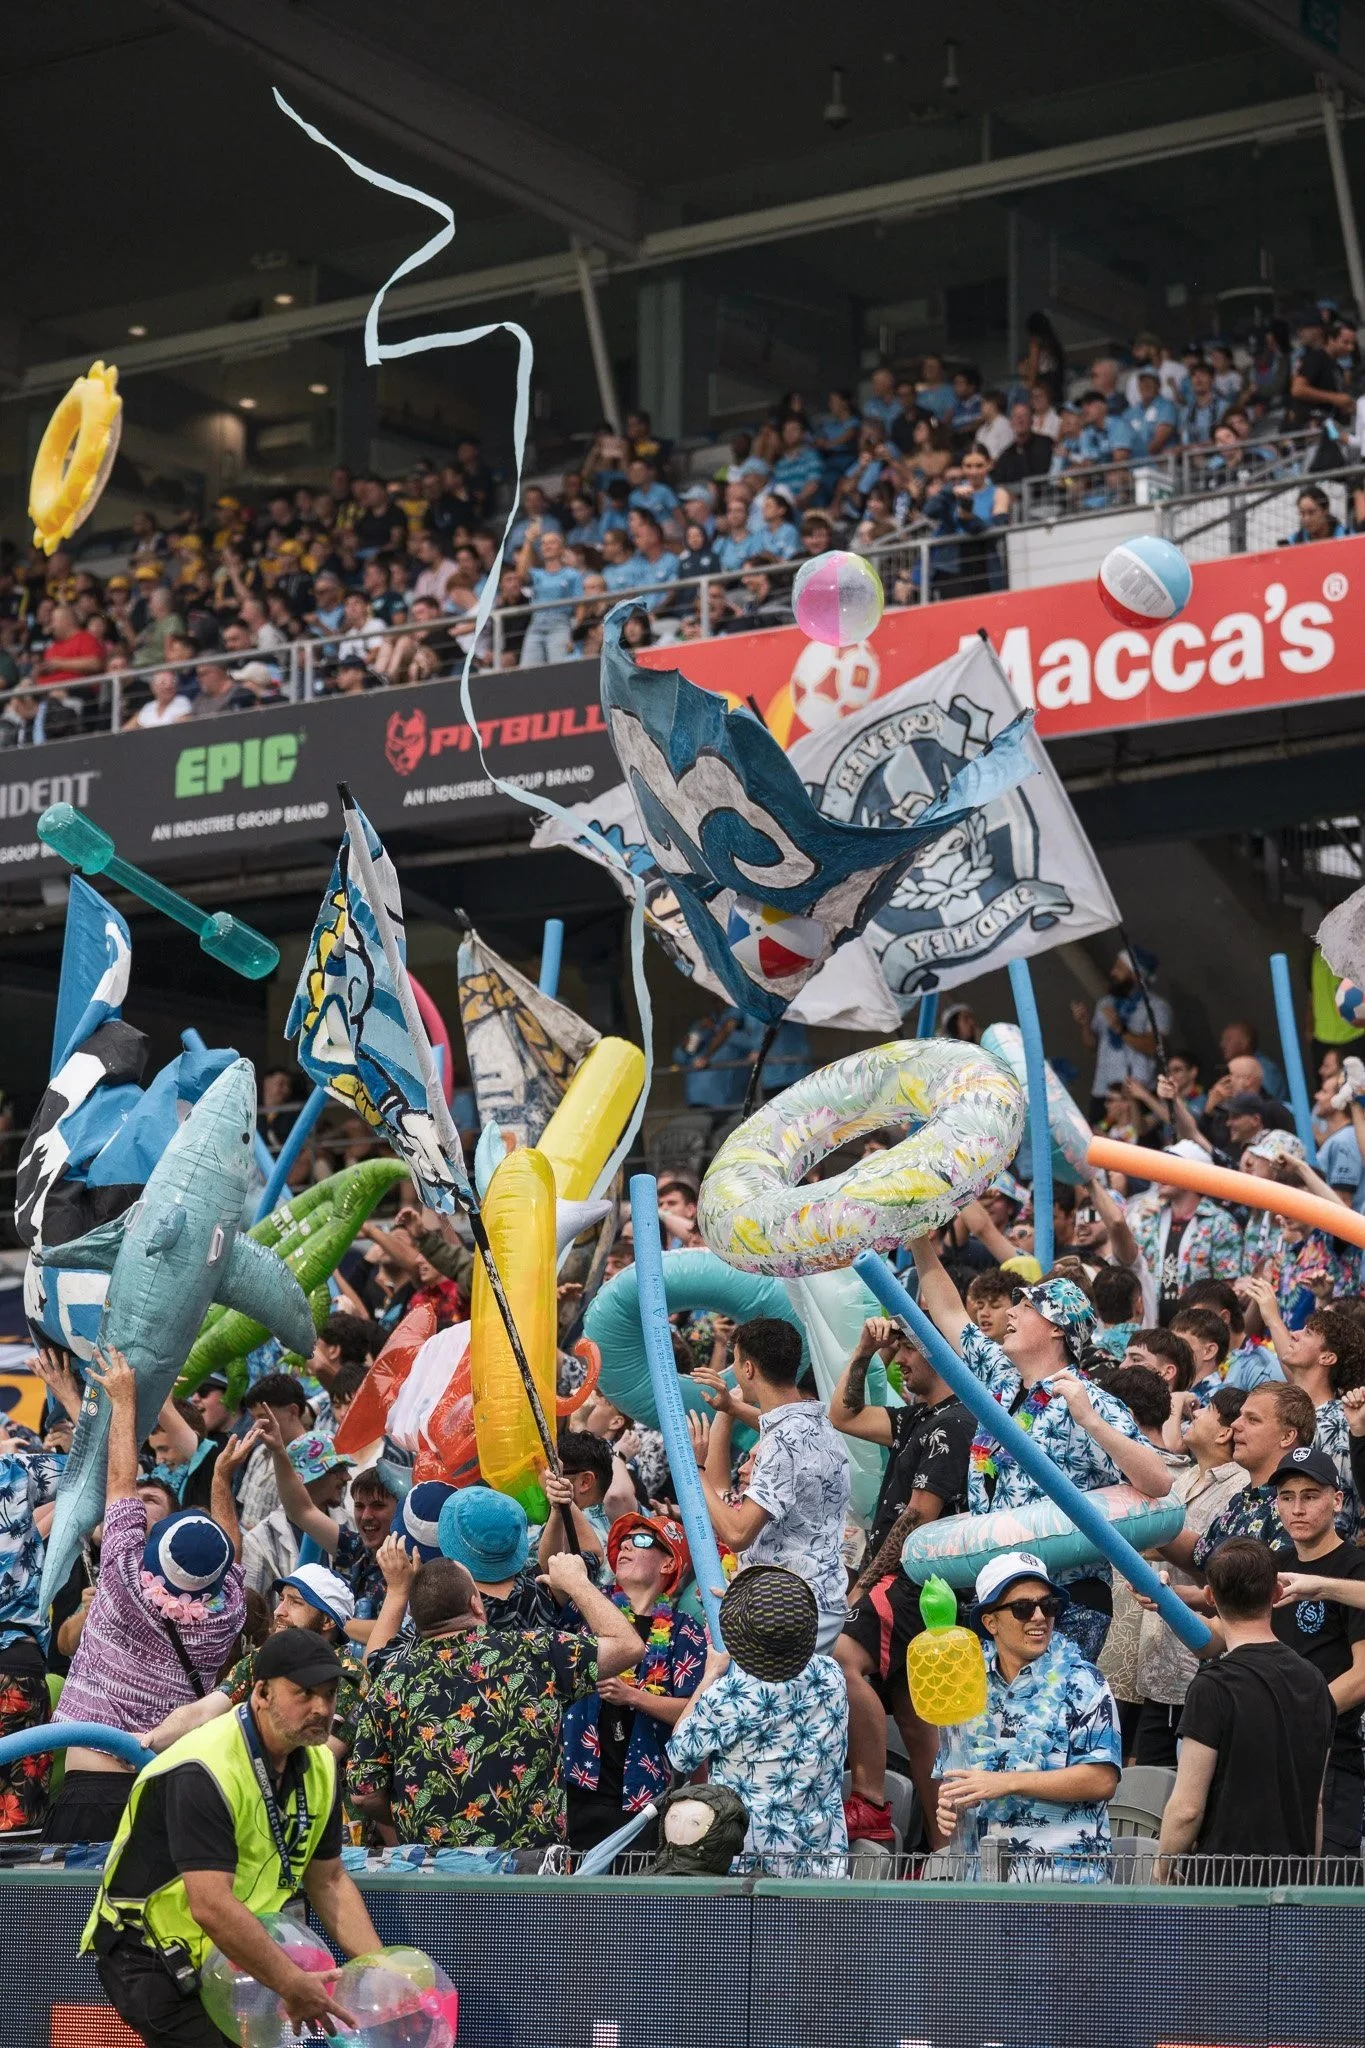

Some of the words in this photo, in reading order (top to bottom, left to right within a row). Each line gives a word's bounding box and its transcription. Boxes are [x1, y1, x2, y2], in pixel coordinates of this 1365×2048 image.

[429, 704, 608, 757] PITBULL
[175, 732, 298, 799] EPIC
[403, 787, 426, 807] AN
[427, 779, 495, 803] INDUSTREE
[545, 764, 595, 788] BRAND
[151, 823, 172, 842] AN
[173, 814, 236, 838] INDUSTREE
[236, 807, 283, 830] GROUP
[284, 801, 330, 823] BRAND
[266, 1799, 290, 1868] ELECTRONICS
